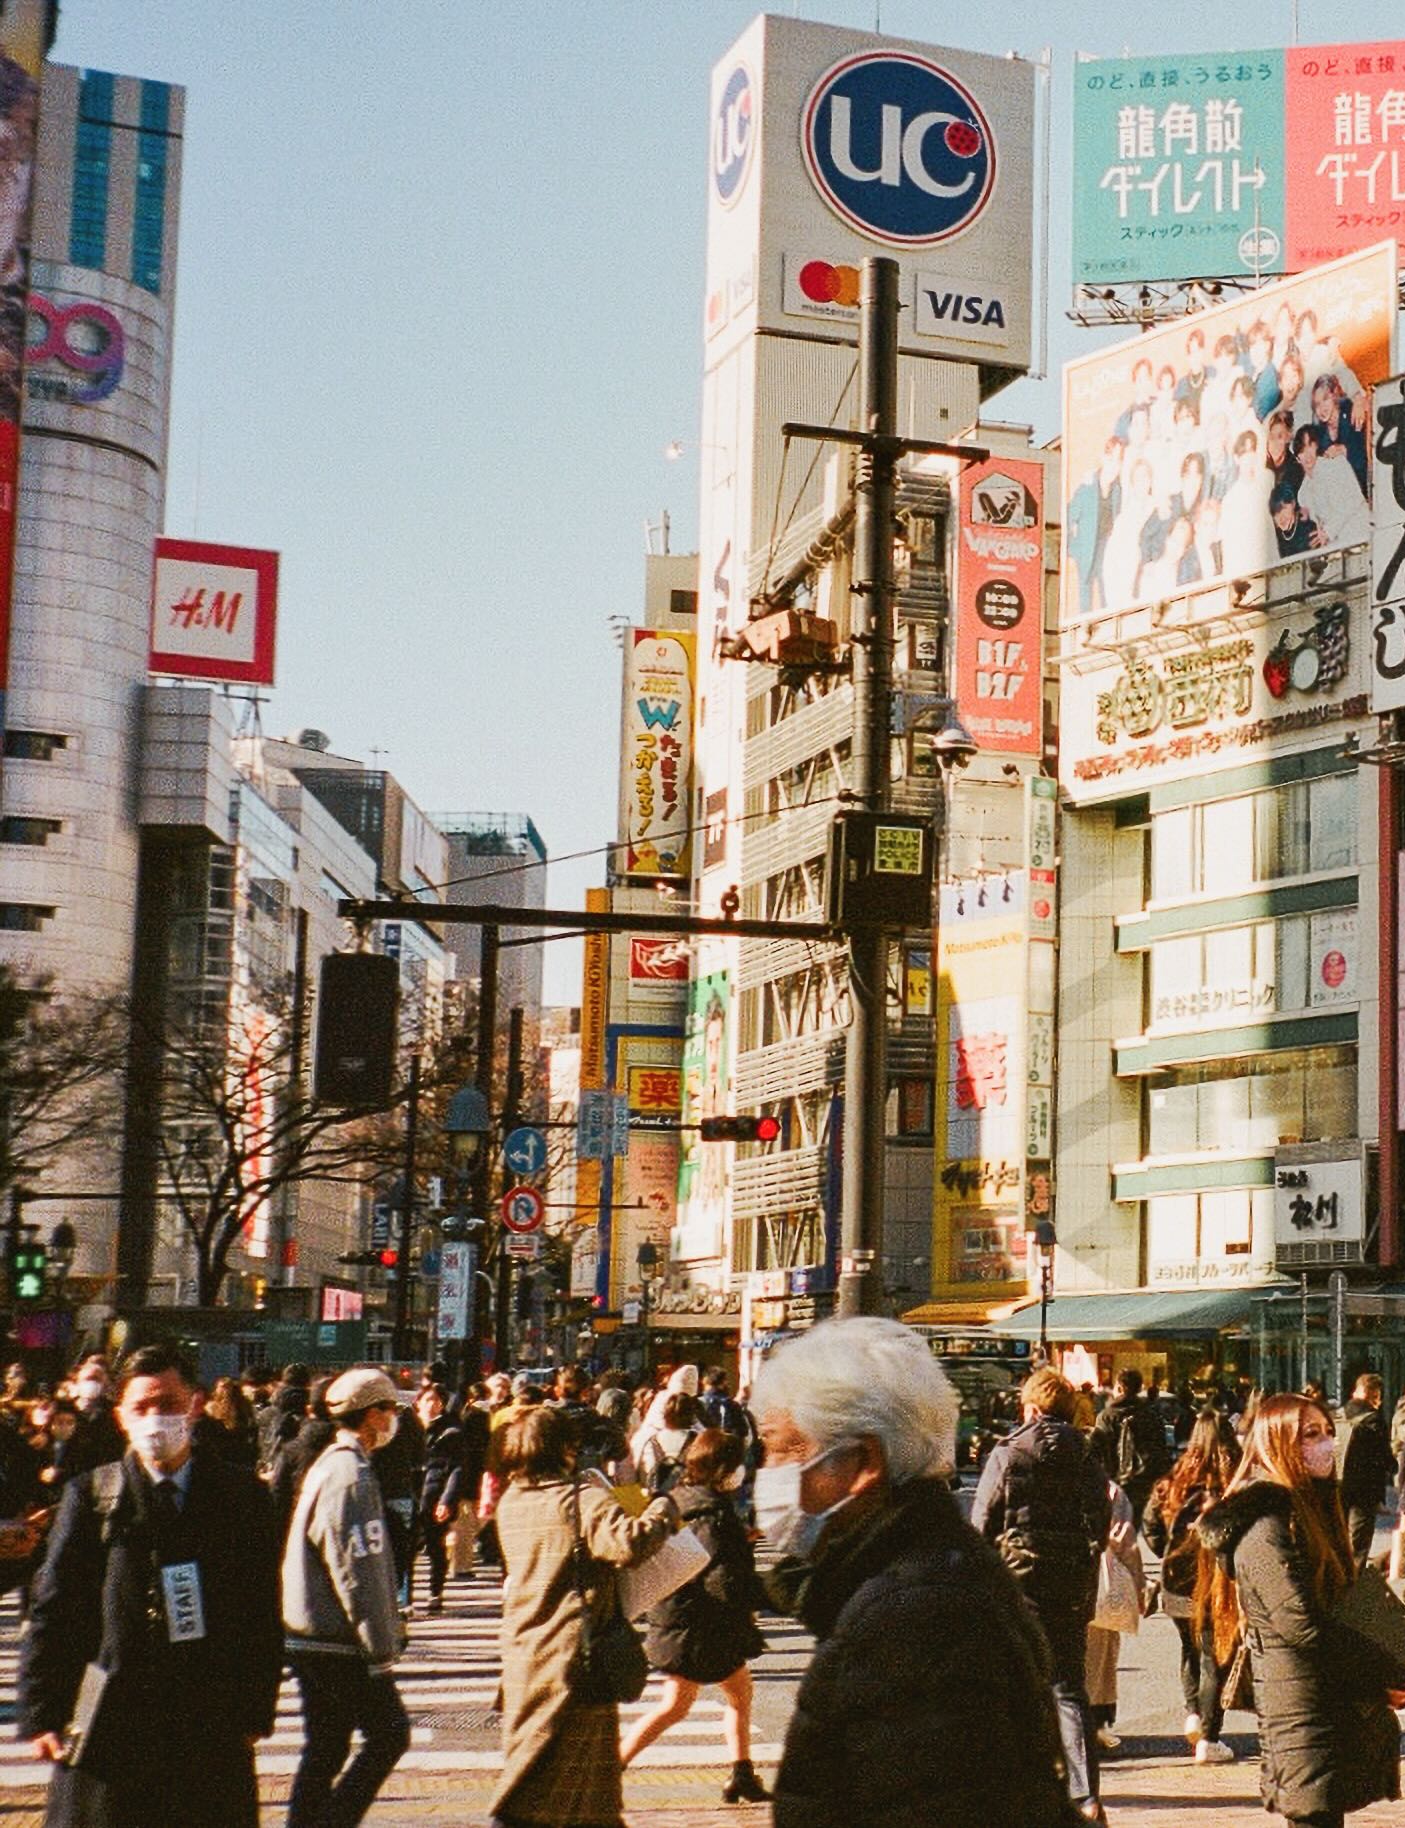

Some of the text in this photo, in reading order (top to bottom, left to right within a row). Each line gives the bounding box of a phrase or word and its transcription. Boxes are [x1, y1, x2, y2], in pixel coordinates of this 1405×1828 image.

[1087, 64, 1273, 91] のど、直接、うるおう
[830, 94, 975, 198] UC
[1117, 98, 1243, 160] 龍角散
[1099, 155, 1267, 219] ダイレクト
[801, 303, 860, 320] mastercar
[924, 288, 1005, 329] VISA
[170, 586, 242, 635] H&M
